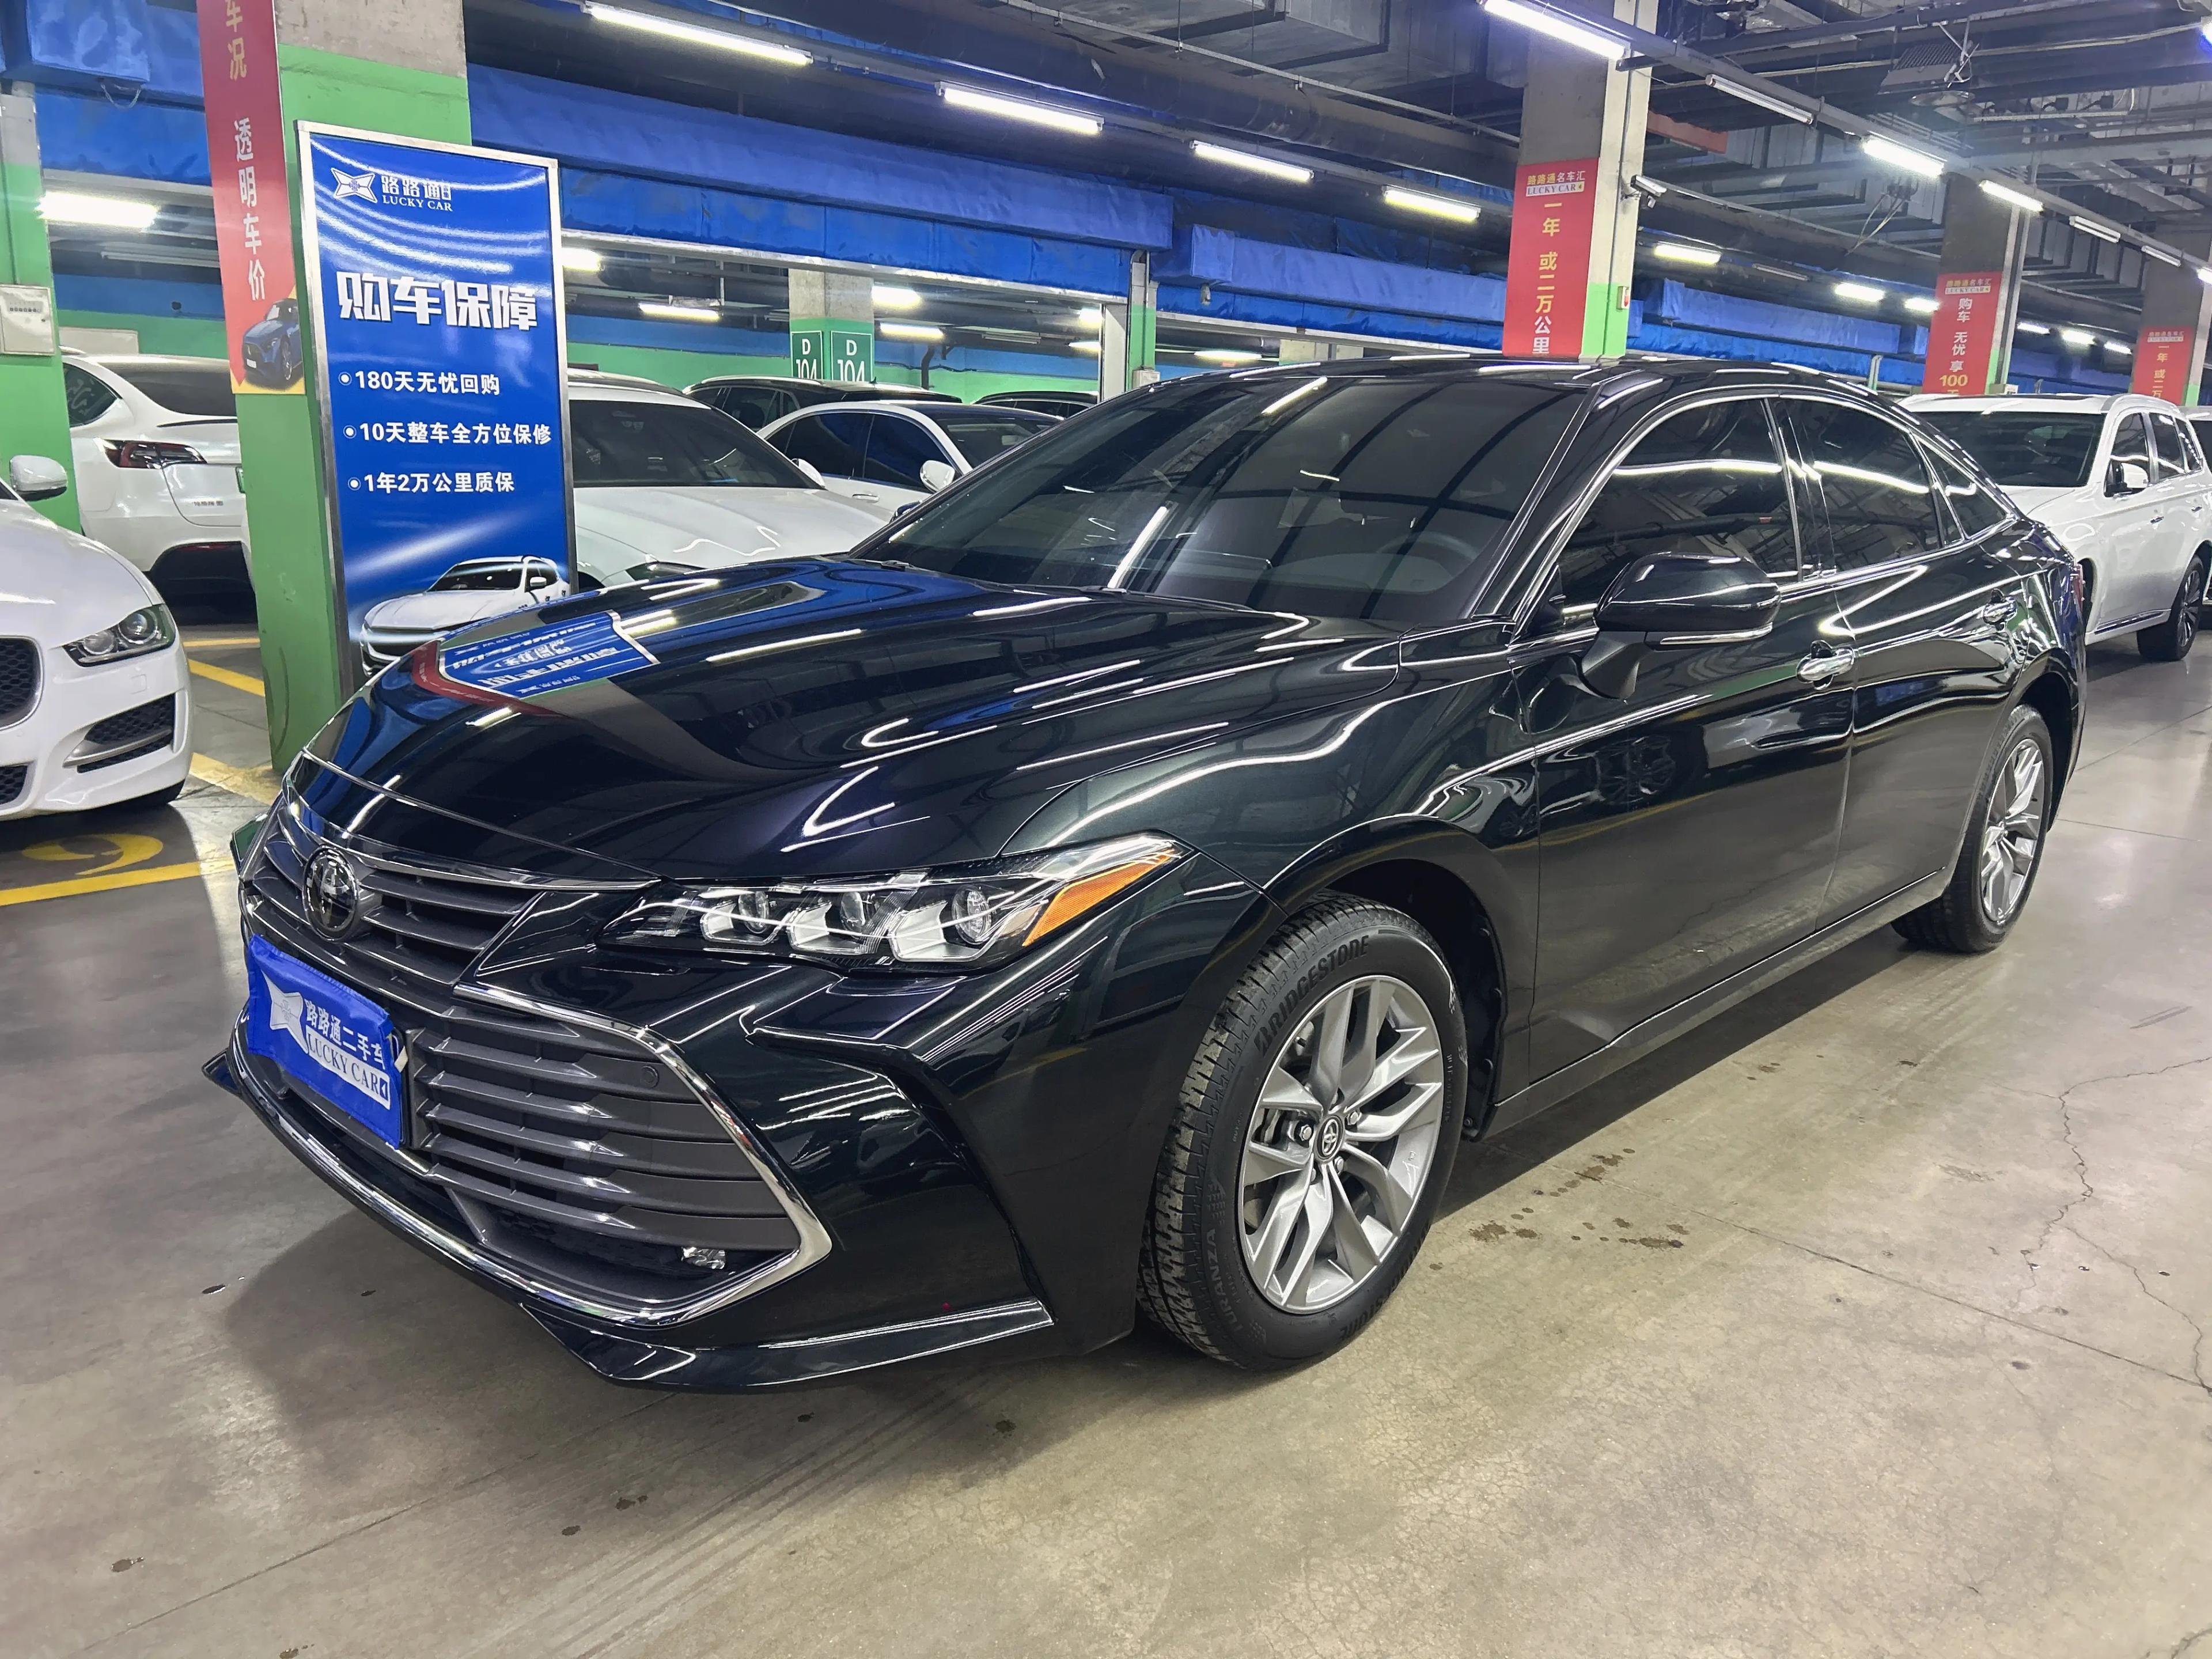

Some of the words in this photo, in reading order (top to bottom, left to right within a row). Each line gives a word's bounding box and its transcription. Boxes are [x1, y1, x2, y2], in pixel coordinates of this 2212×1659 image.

[225, 0, 247, 80] 车况
[1527, 171, 1585, 185] 路路通名车汇
[1528, 185, 1556, 195] LUCKY
[1559, 183, 1575, 192] CAR
[234, 118, 265, 301] 透明车价
[382, 195, 423, 207] LUCKY
[427, 200, 453, 211] CAR
[336, 271, 537, 330] 购车保障
[802, 339, 811, 355] D
[846, 339, 857, 355] D
[355, 371, 500, 395] 180天无忧回购
[1940, 374, 1968, 387] 100
[359, 422, 552, 445] 10天整车全方位保修
[365, 472, 514, 493] 1年2万公里质保
[1253, 935, 1369, 1056] BRIDGESTONE
[305, 998, 386, 1070] 路路通二手车
[308, 1031, 348, 1076] LUCKY
[351, 1061, 378, 1094] CAR
